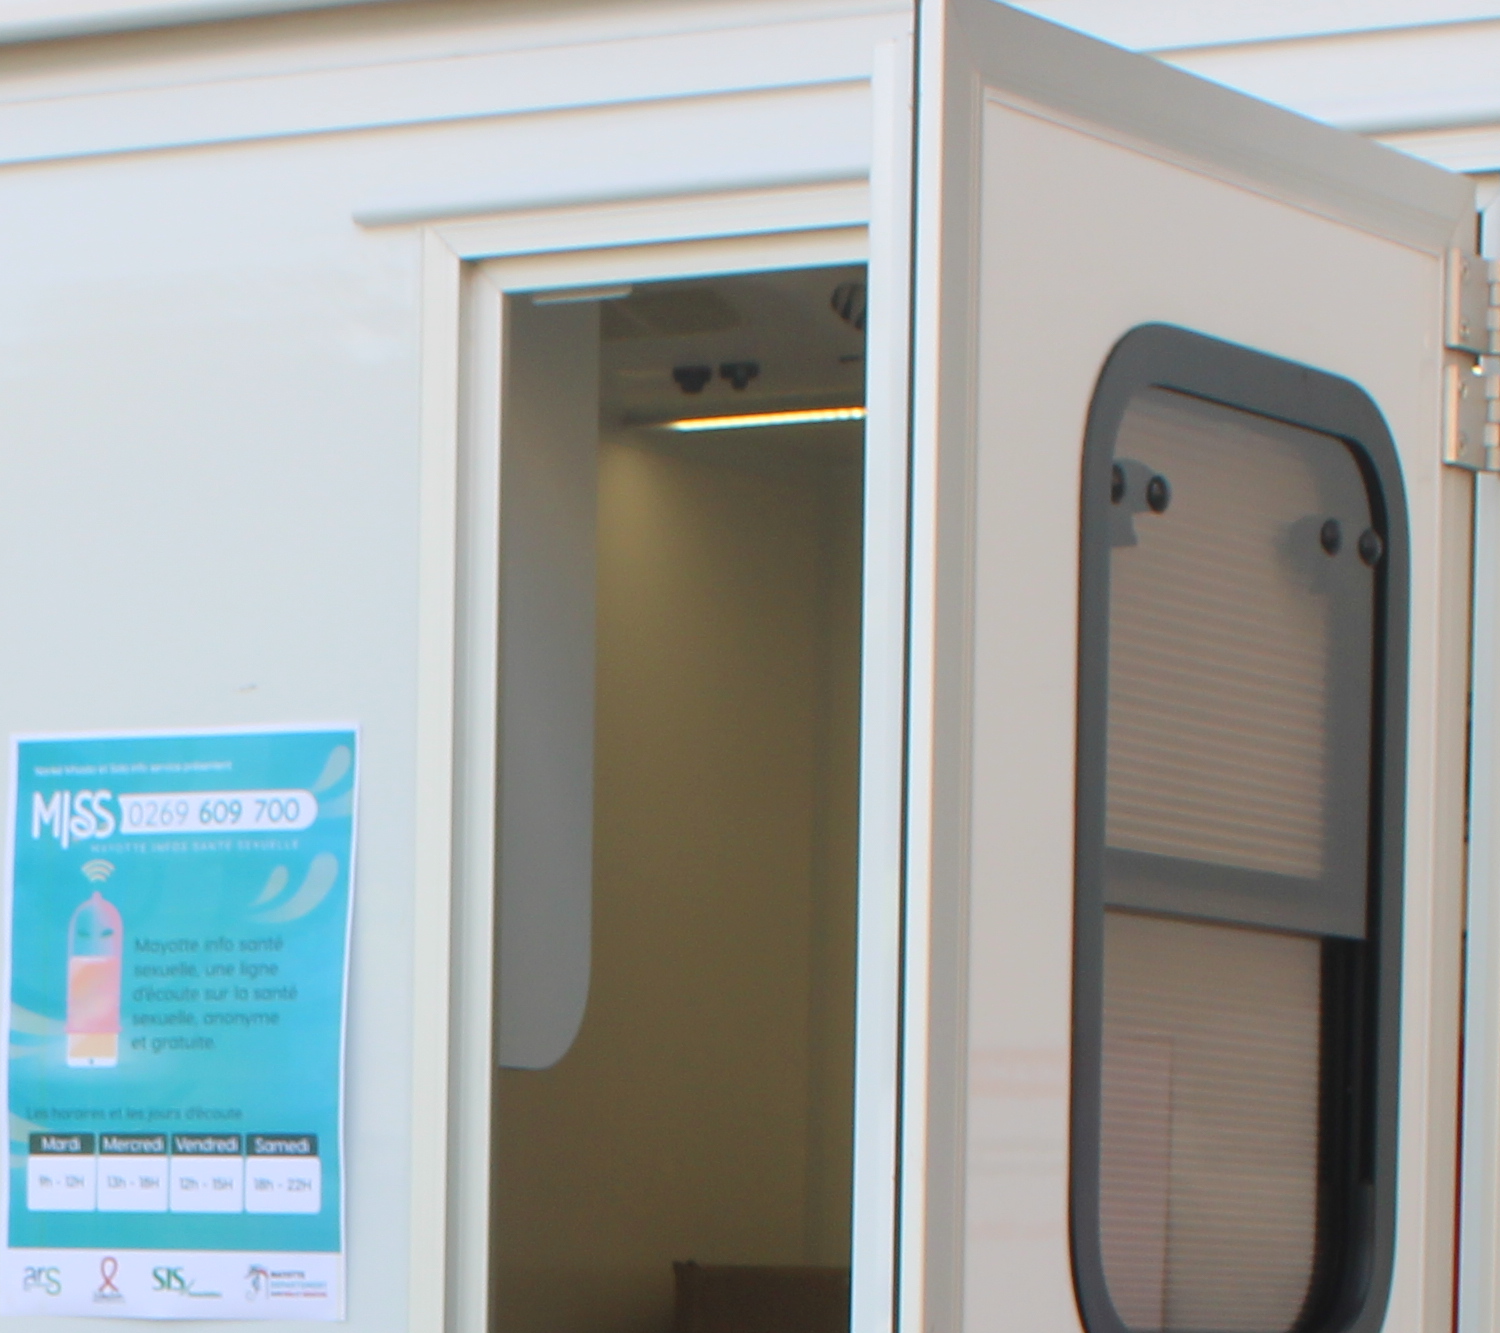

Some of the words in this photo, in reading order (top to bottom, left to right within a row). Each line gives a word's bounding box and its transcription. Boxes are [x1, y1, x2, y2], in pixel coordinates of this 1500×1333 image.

[32, 788, 116, 850] MISS
[129, 798, 190, 827] 0269
[199, 797, 243, 825] 609
[254, 797, 301, 823] 700
[131, 1036, 146, 1050] et
[40, 1136, 81, 1151] Mardi
[103, 1137, 164, 1152] Mercredi
[176, 1137, 239, 1153] Vendredi
[253, 1138, 310, 1153] Samedi
